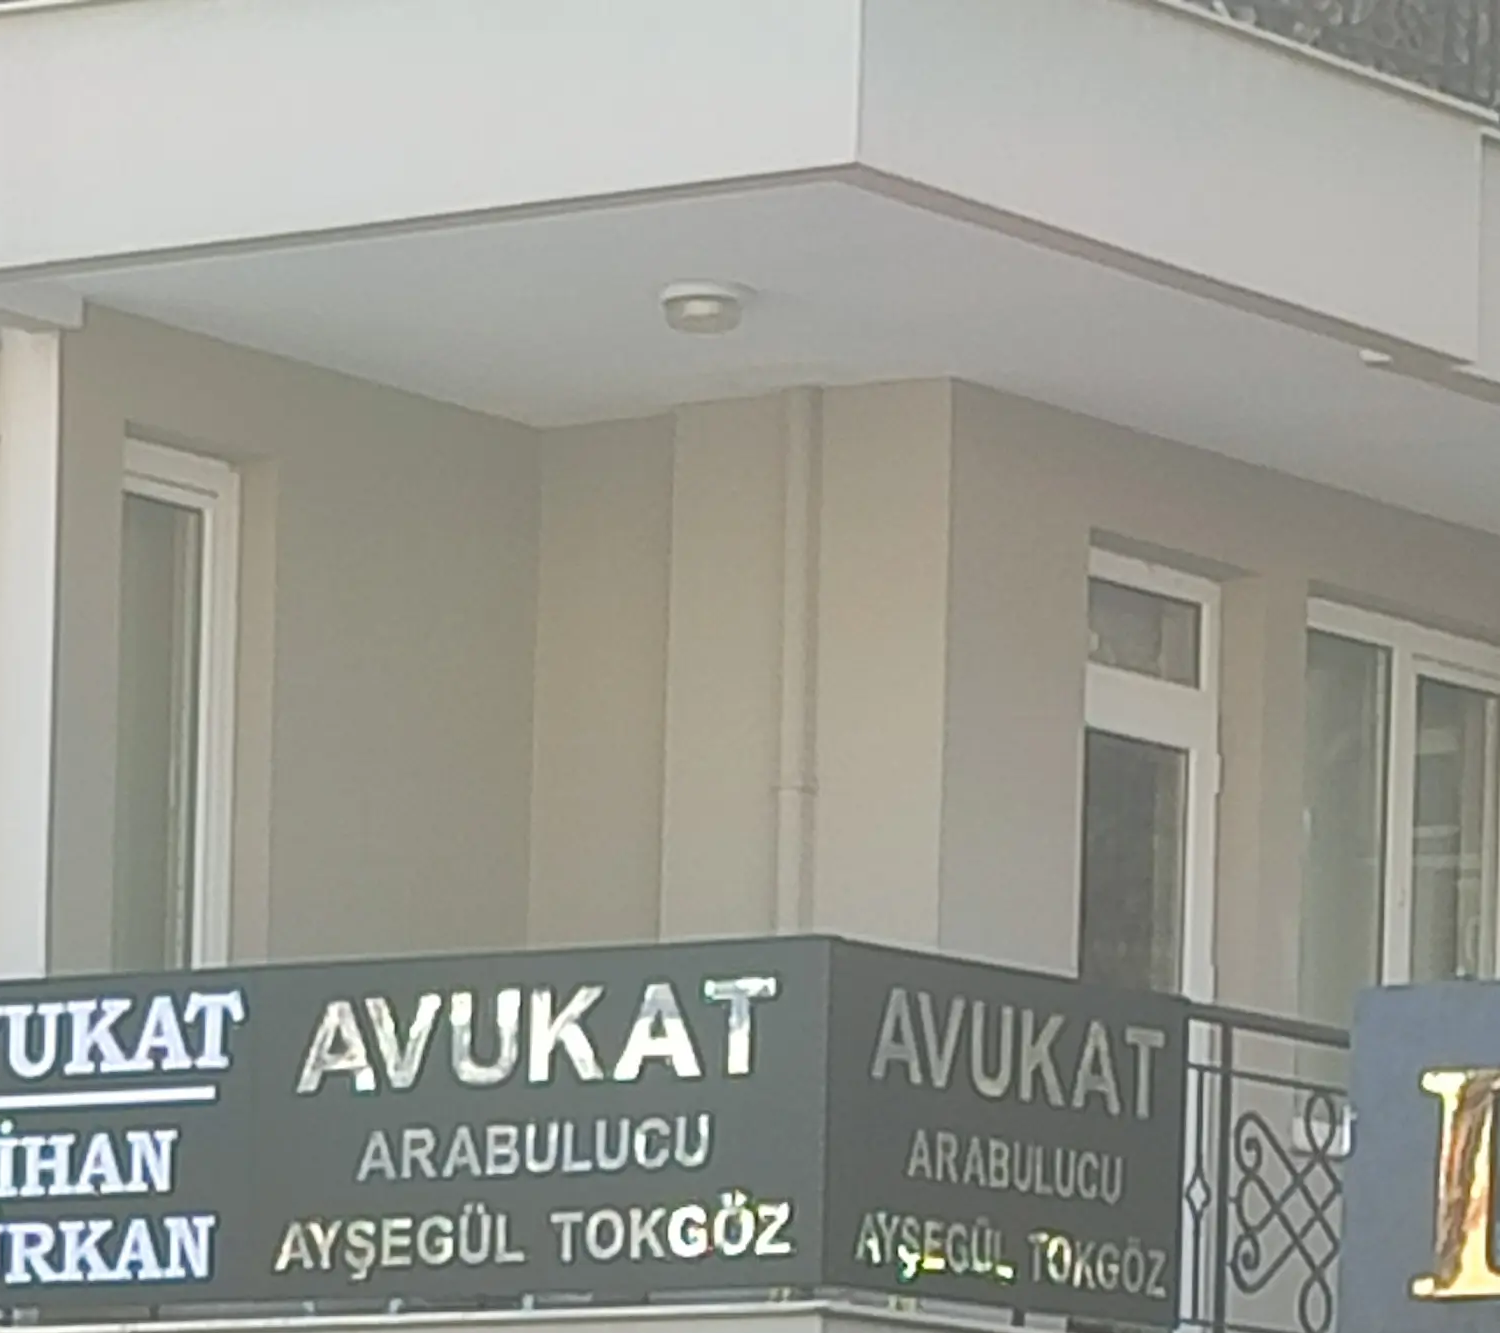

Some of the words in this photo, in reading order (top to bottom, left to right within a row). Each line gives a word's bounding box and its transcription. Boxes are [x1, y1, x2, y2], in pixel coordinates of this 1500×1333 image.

[296, 976, 778, 1094] AVUKAT
[871, 986, 1166, 1120] AVUKAT
[357, 1114, 712, 1182] ARABULUCU
[907, 1128, 1123, 1205] ARABULUCU
[273, 1203, 526, 1280] AYŞEGÜL
[550, 1190, 793, 1263] TOKGÖZ
[855, 1211, 1014, 1280] AYŞEGÜL
[1028, 1232, 1167, 1298] TOKGÖZ
